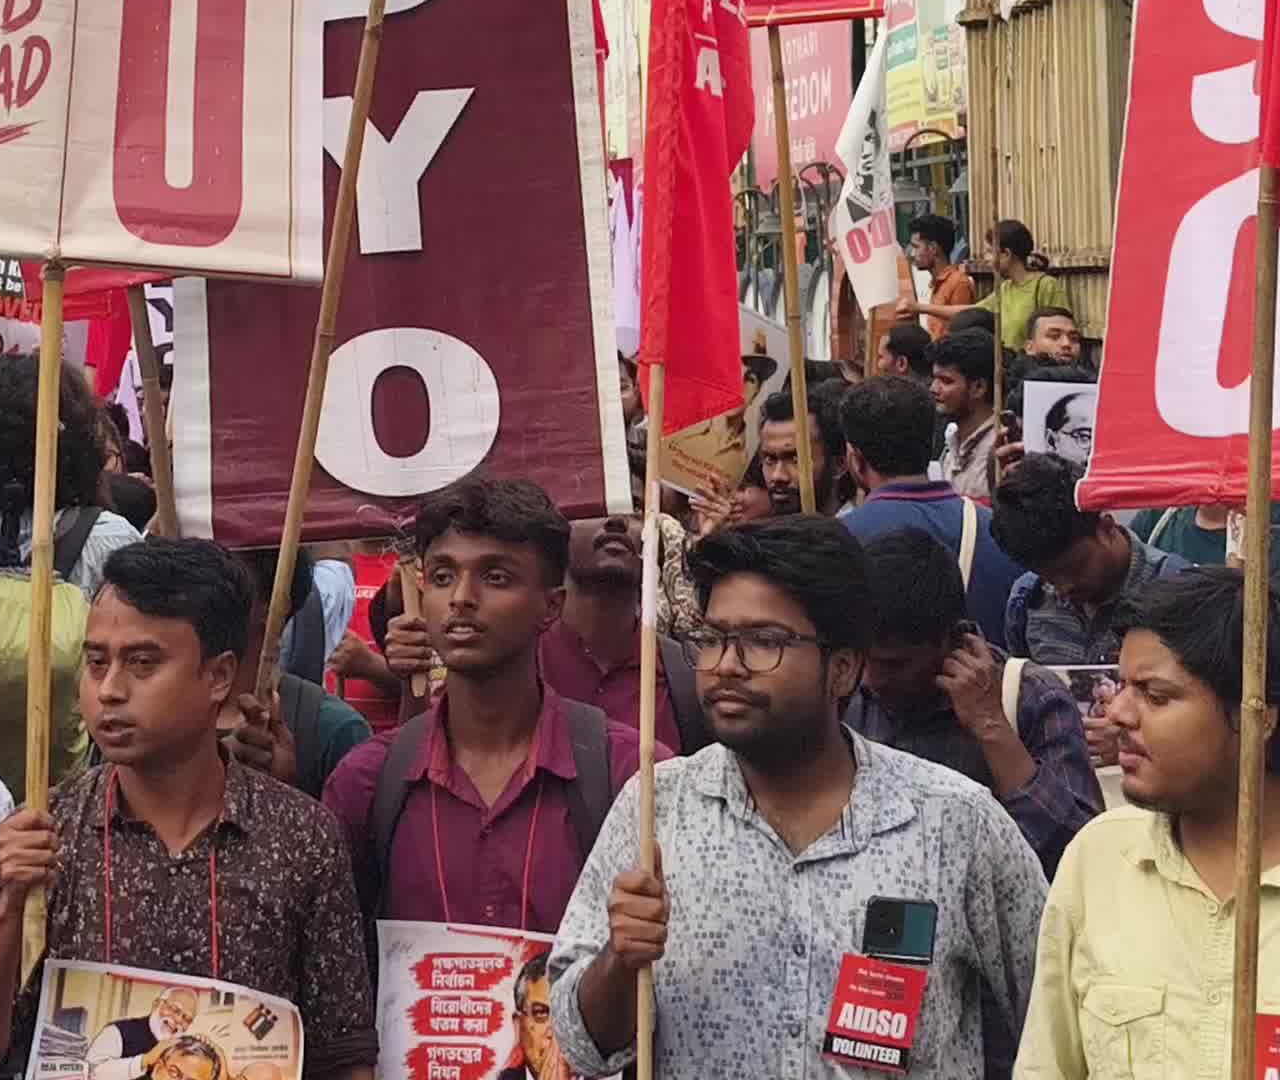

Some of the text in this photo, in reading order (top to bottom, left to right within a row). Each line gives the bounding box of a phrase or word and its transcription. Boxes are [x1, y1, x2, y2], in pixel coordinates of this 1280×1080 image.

[6, 275, 22, 292] be
[837, 1001, 908, 1040] AIDSO
[832, 1036, 901, 1066] VOLUNTEER
